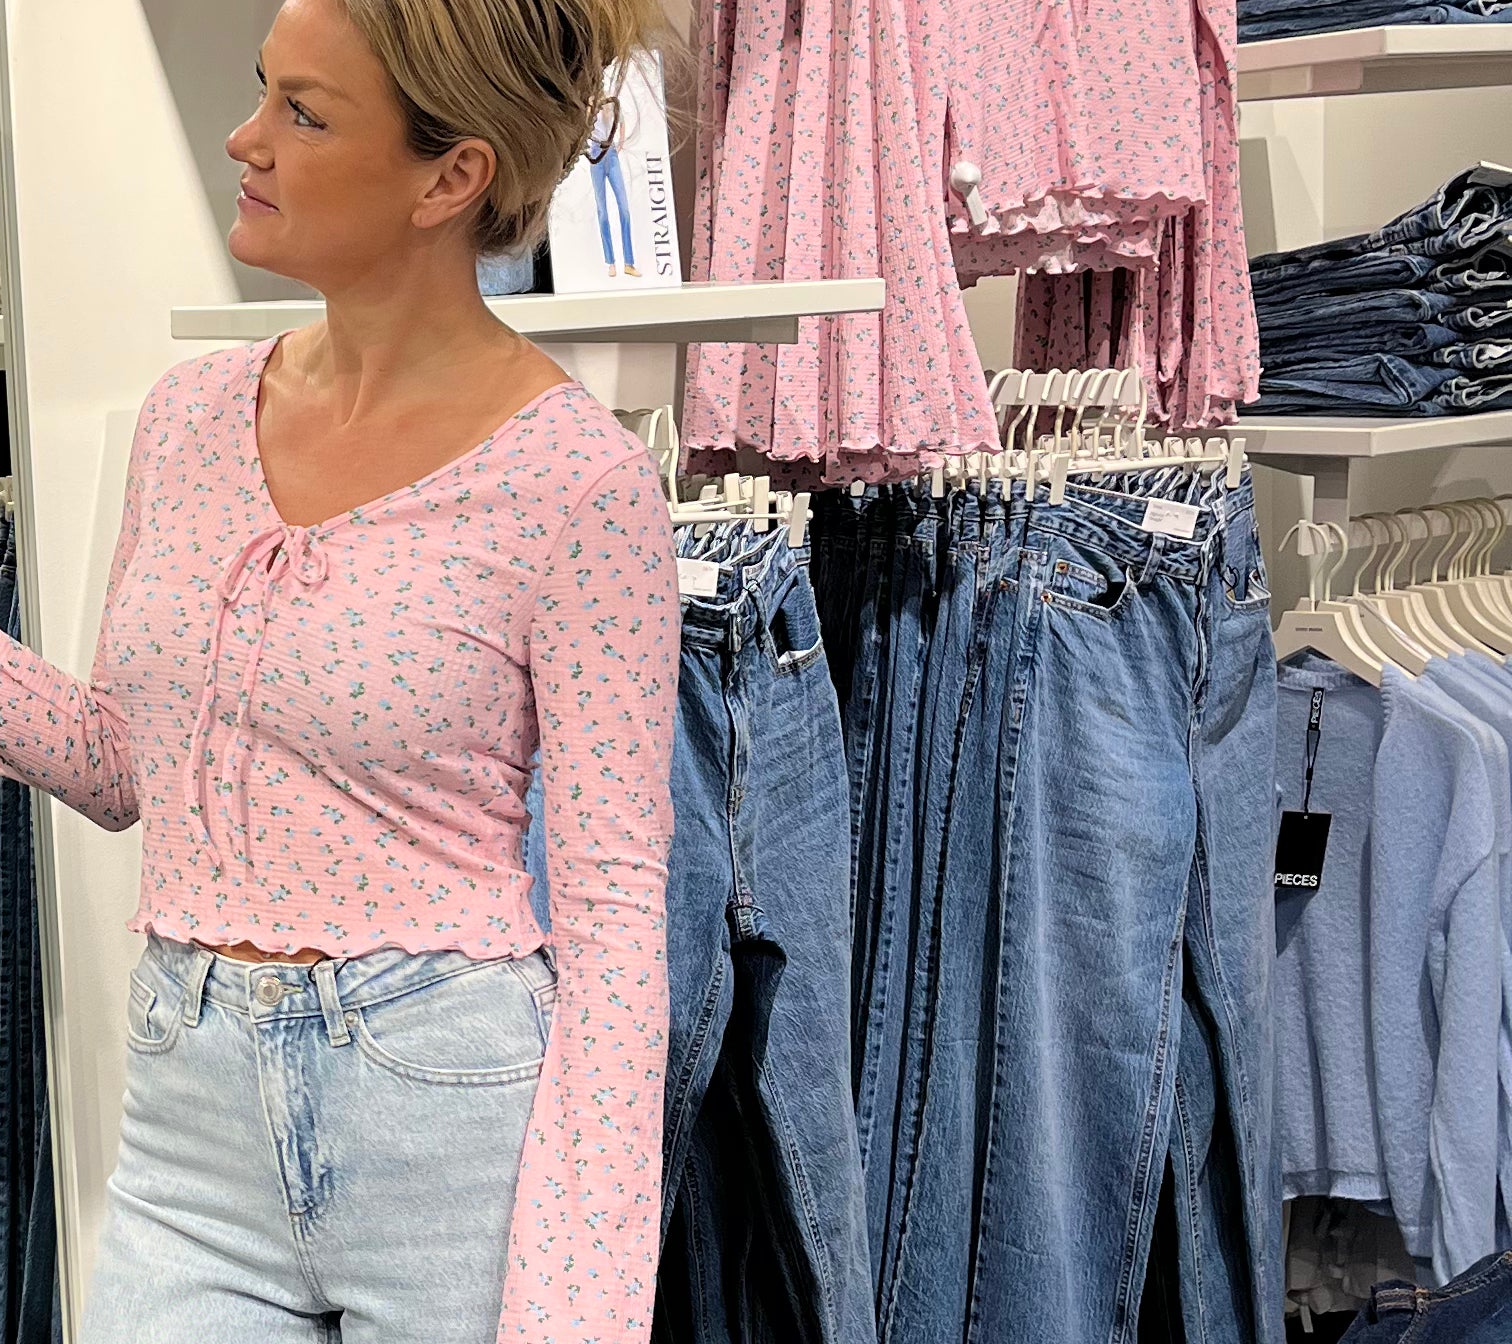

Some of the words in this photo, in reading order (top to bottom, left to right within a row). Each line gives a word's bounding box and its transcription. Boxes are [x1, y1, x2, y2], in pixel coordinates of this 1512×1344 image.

[646, 152, 673, 276] STRAIGHT
[1311, 691, 1323, 724] PIECES
[1275, 872, 1318, 886] PIECES
